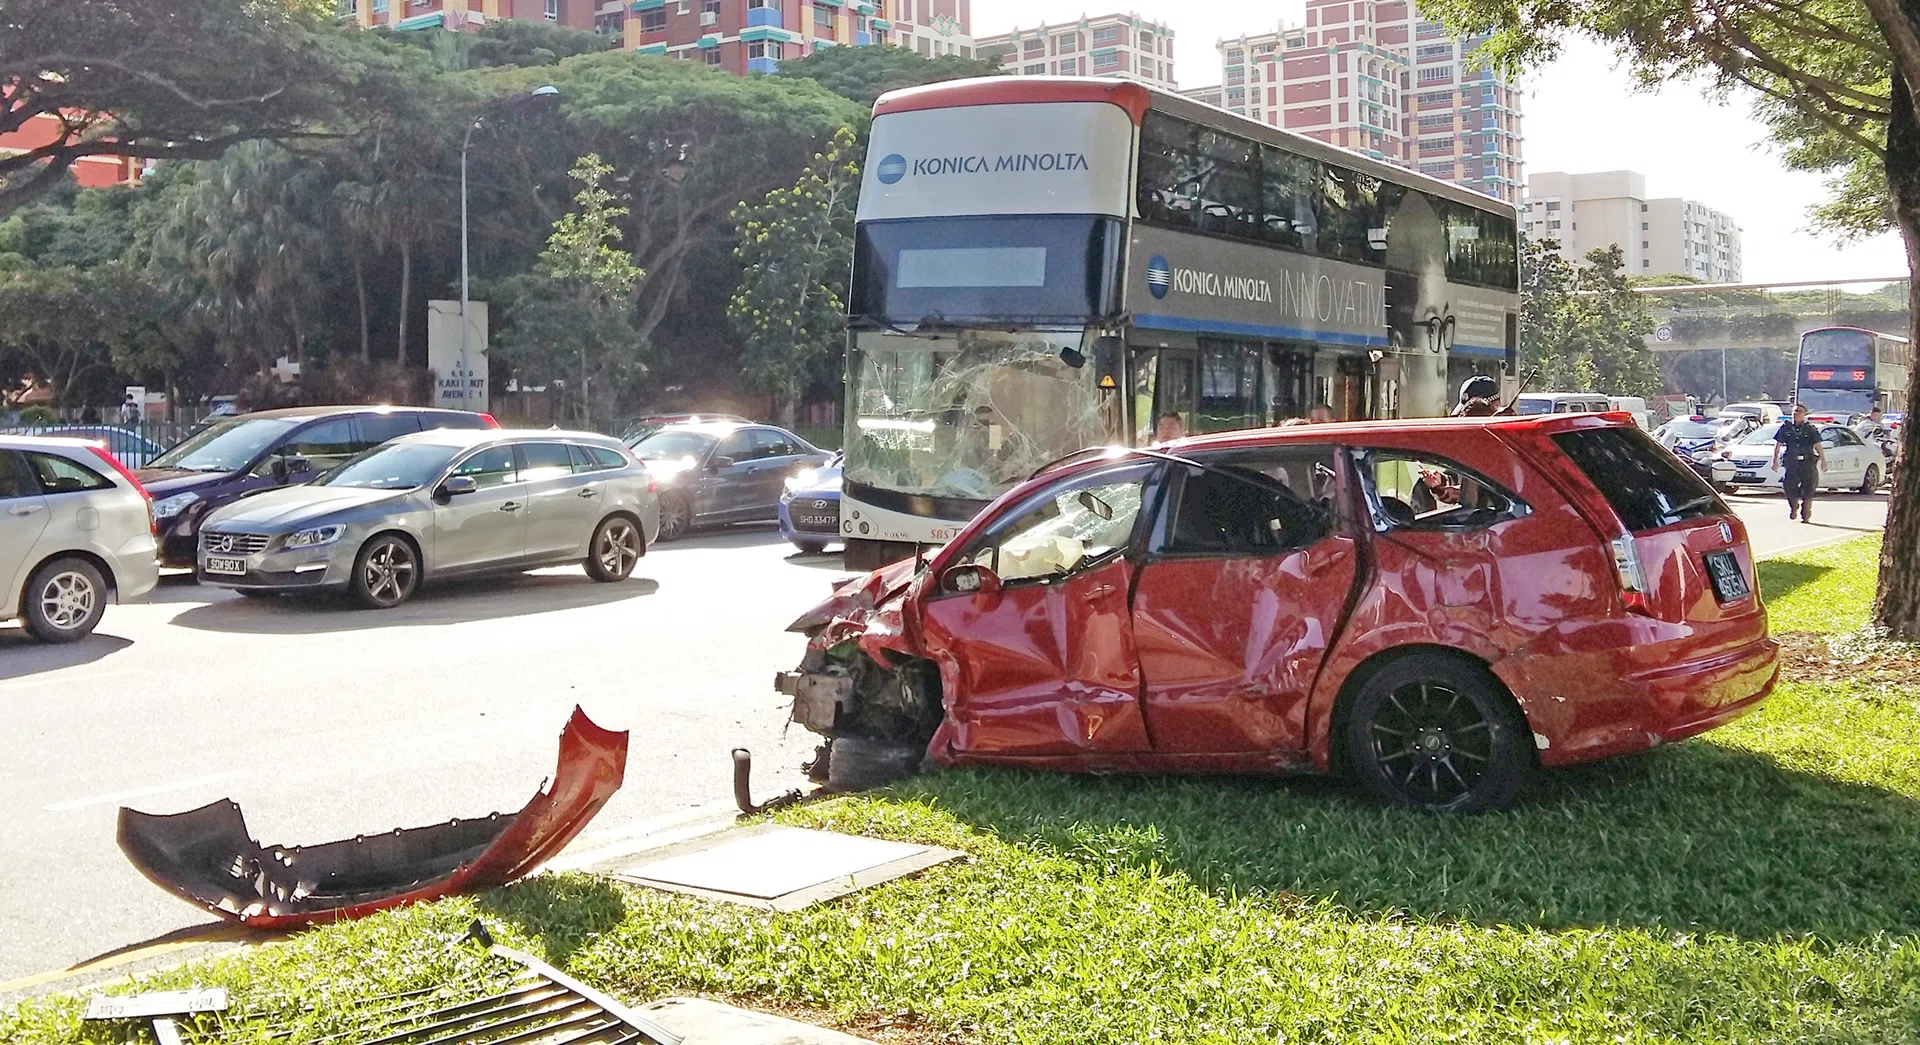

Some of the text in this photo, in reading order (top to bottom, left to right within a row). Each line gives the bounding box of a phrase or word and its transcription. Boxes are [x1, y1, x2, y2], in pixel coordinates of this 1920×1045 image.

[913, 153, 1089, 176] KONICA MINOLTA
[1174, 268, 1272, 303] KONICA MINOLTA
[1280, 268, 1392, 328] INNOVATIVE
[1852, 371, 1866, 381] 55
[438, 379, 460, 388] KAKI
[442, 390, 473, 399] AVENE
[930, 529, 949, 539] SBS
